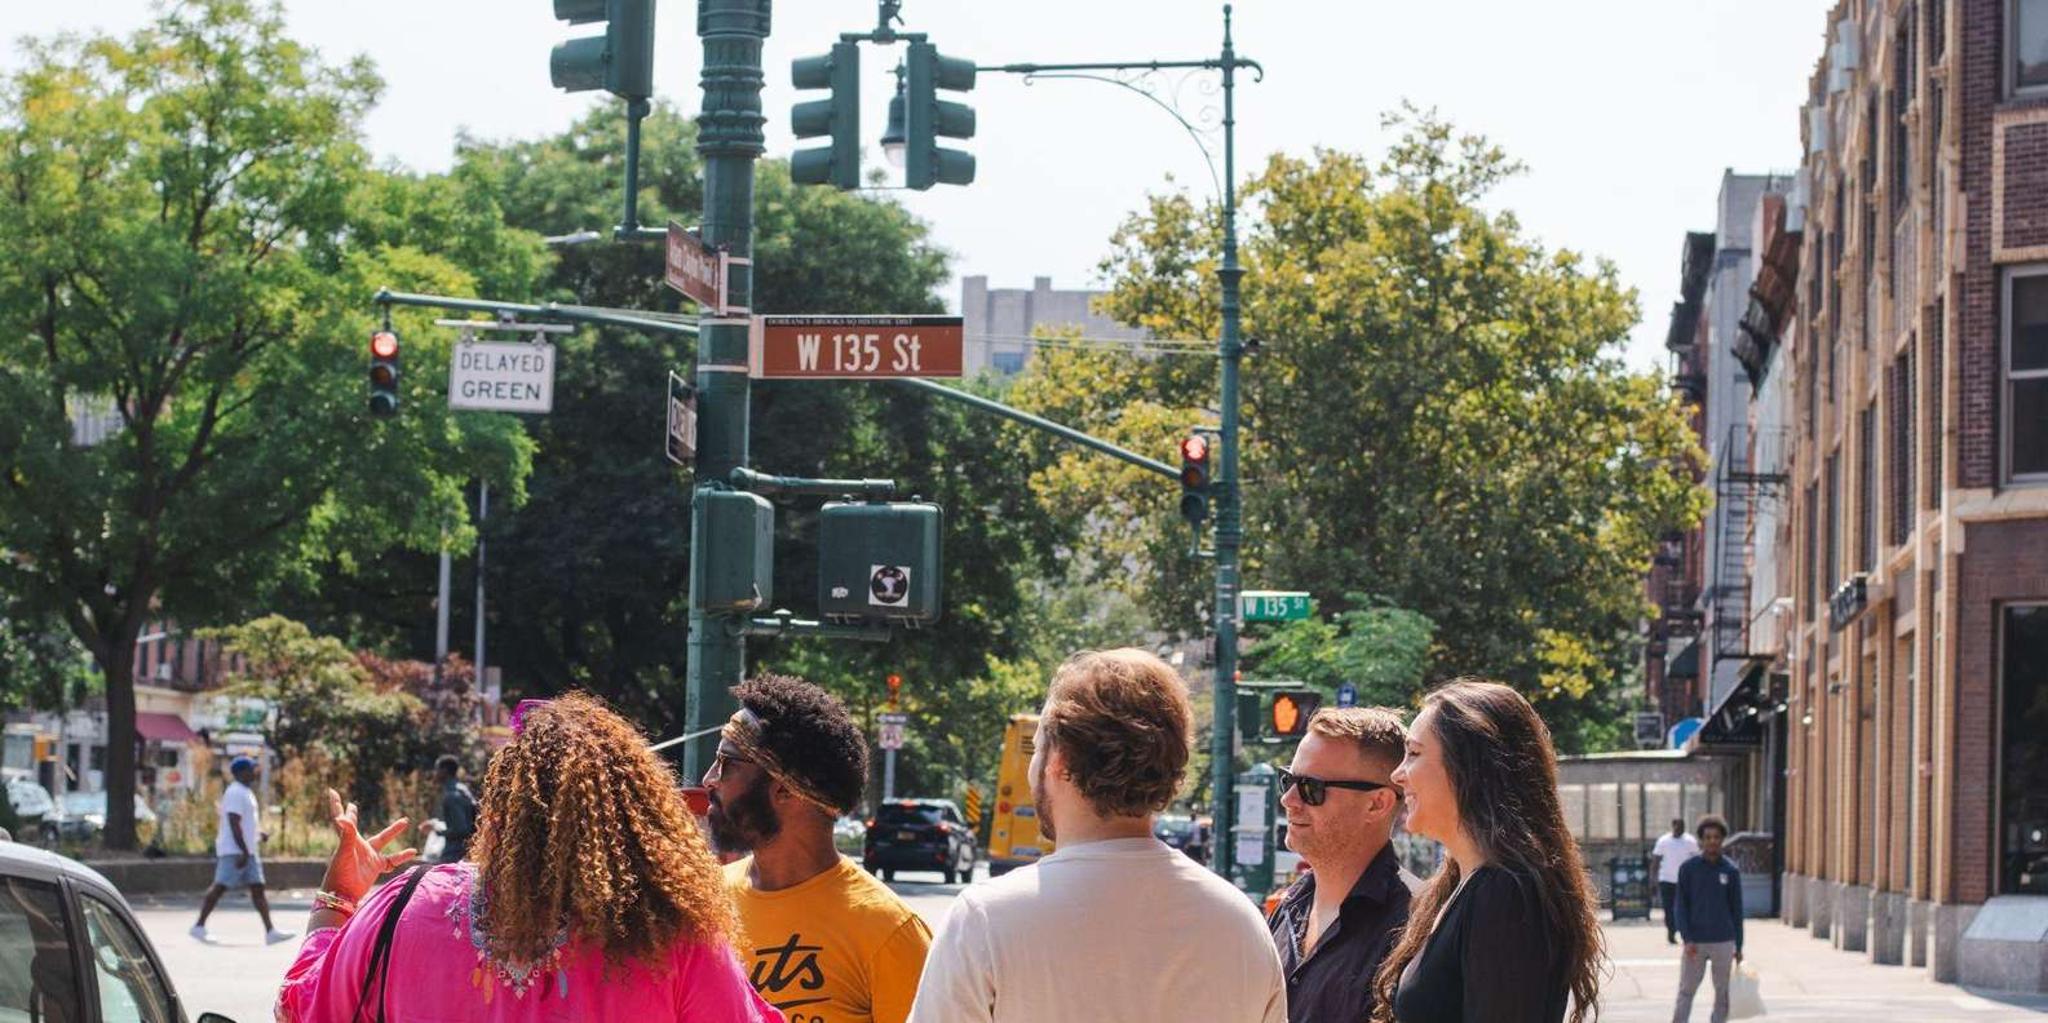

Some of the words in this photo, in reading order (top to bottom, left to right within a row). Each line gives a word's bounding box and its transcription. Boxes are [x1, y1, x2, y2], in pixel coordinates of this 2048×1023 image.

[460, 351, 545, 373] DELAYED
[797, 333, 821, 372] W
[833, 333, 881, 373] 135
[891, 333, 922, 373] St
[461, 380, 541, 401] GREEN
[1245, 596, 1258, 616] W
[1264, 596, 1289, 617] 135
